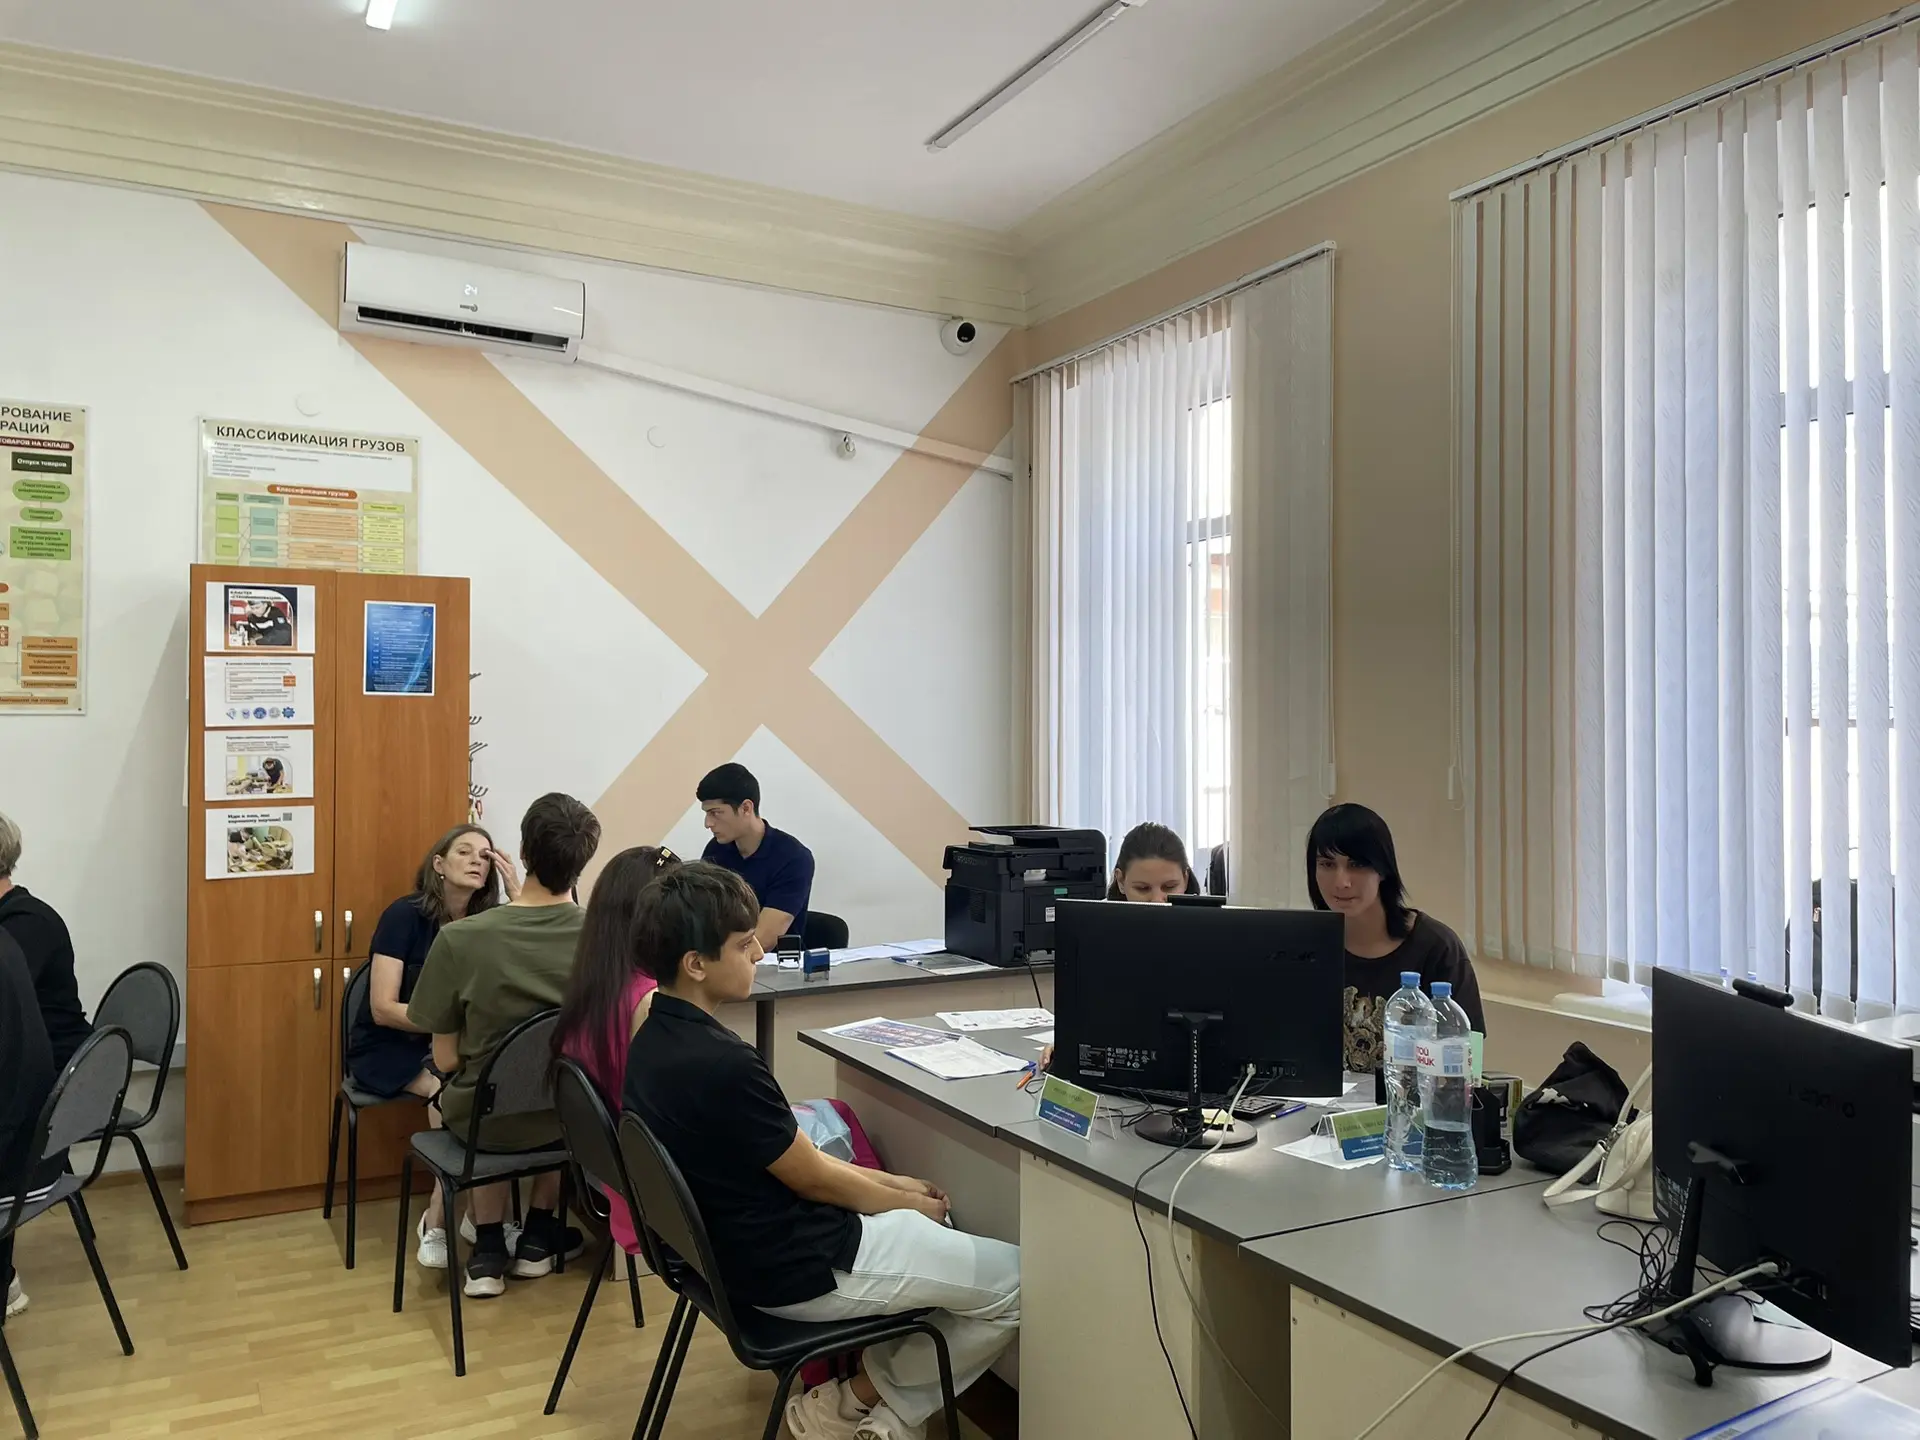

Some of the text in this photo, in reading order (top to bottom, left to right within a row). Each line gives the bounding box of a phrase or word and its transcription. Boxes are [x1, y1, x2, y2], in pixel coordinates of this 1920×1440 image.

[464, 284, 478, 296] 24
[1, 406, 72, 422] РОВАНИЕ
[0, 421, 50, 434] РАЦИЙ
[43, 441, 70, 449] СКЛАДЕ
[216, 426, 405, 453] КЛАССИФИКАЦИЯ ГРУЗОВ
[17, 458, 67, 468] Отпуск товаров
[276, 486, 327, 498] Классификация
[328, 490, 349, 499] грузов
